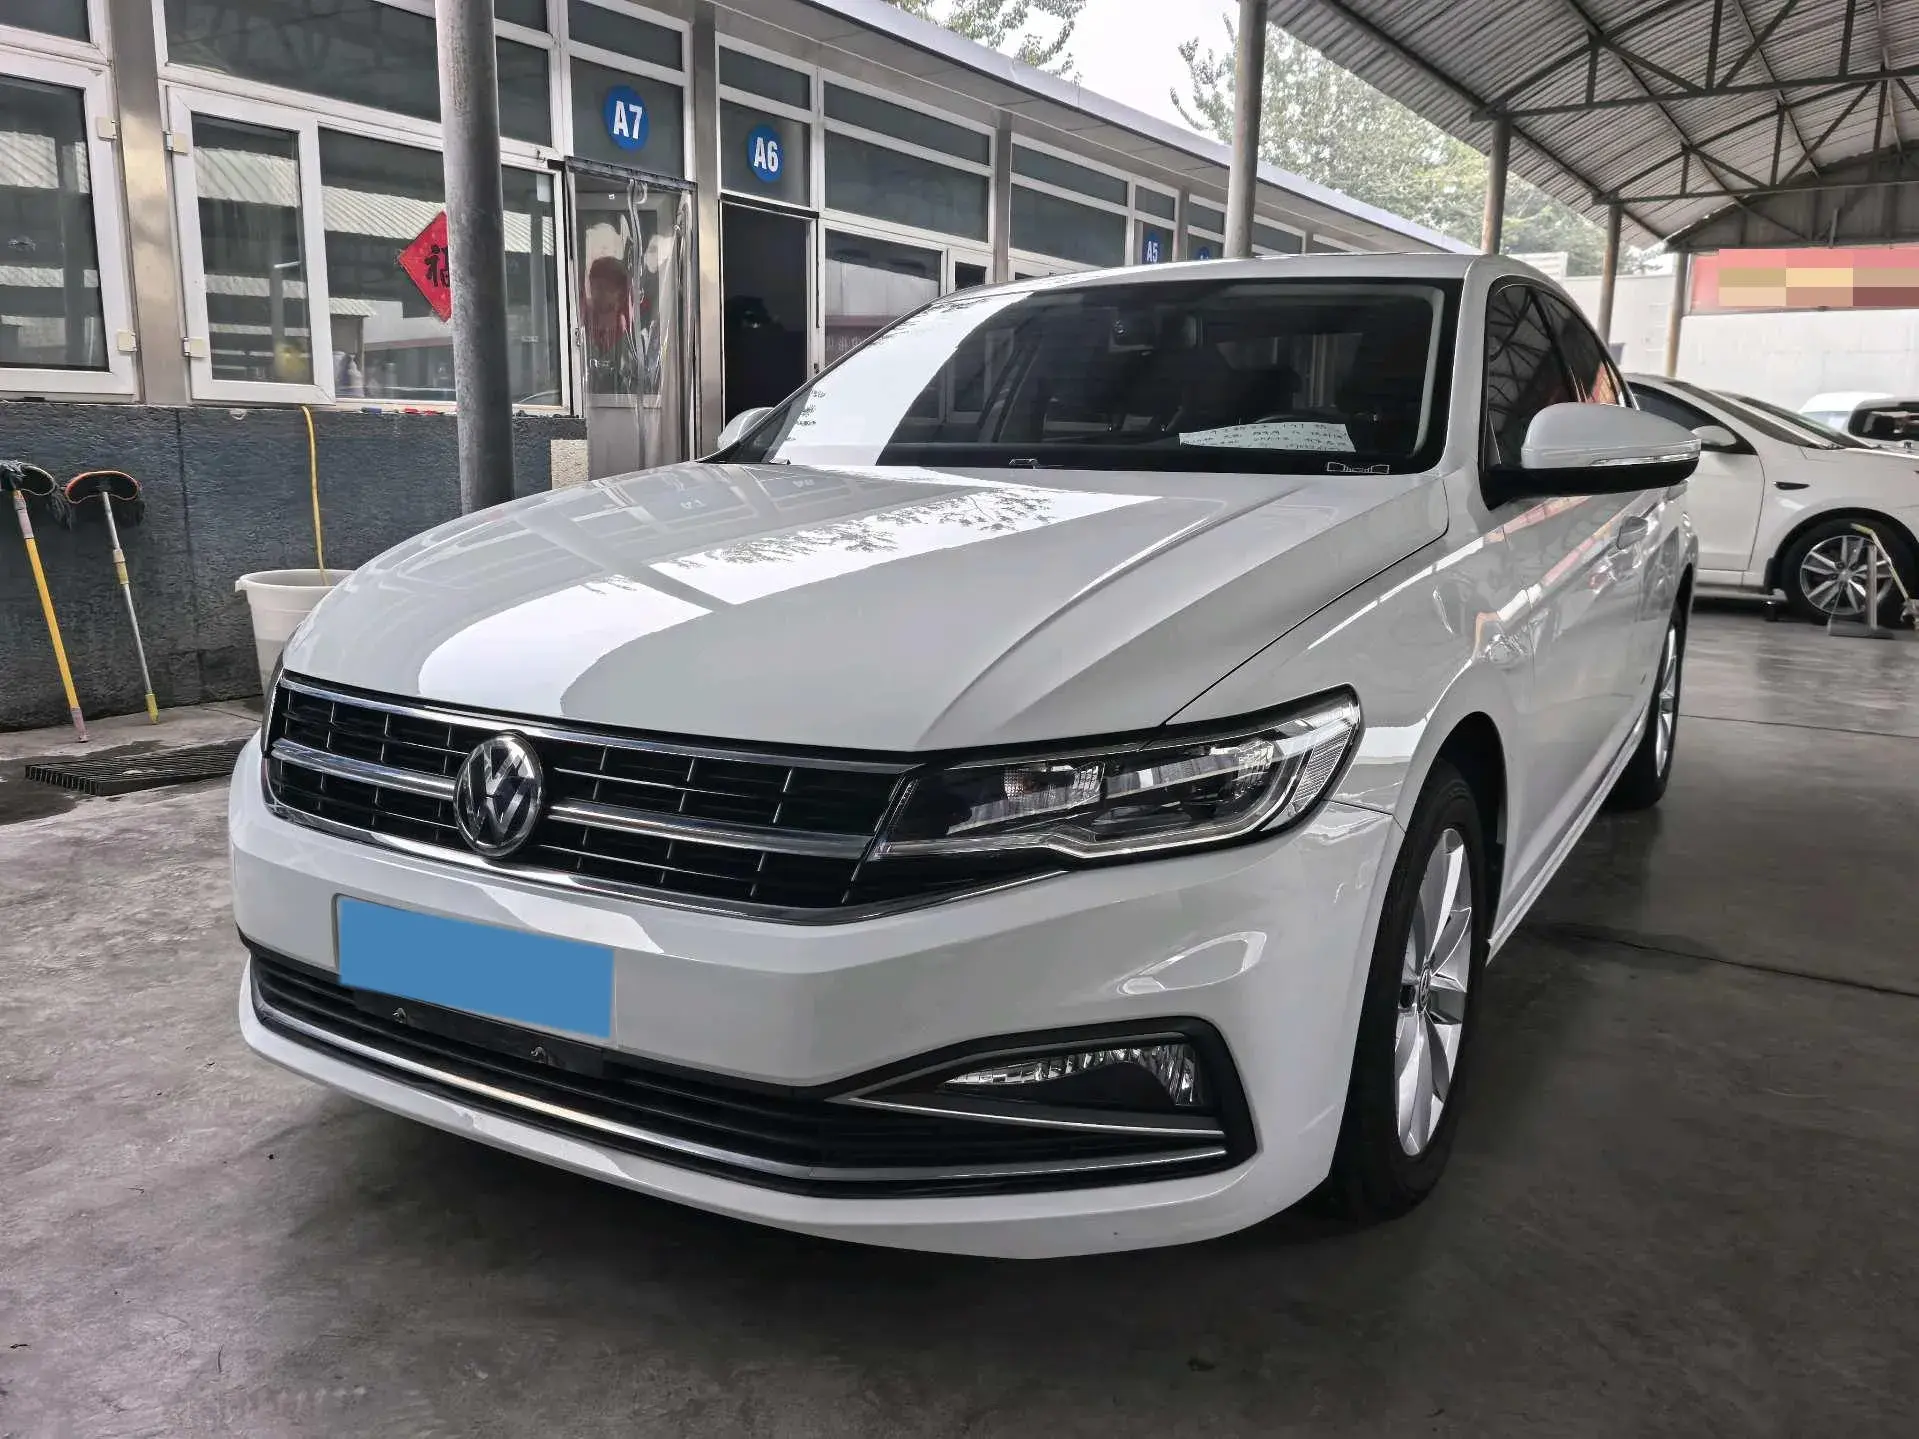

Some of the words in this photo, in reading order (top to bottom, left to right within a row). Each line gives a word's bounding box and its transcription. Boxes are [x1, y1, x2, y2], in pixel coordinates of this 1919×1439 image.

[613, 100, 643, 140] A7
[753, 136, 779, 173] A6
[1146, 240, 1158, 262] A5
